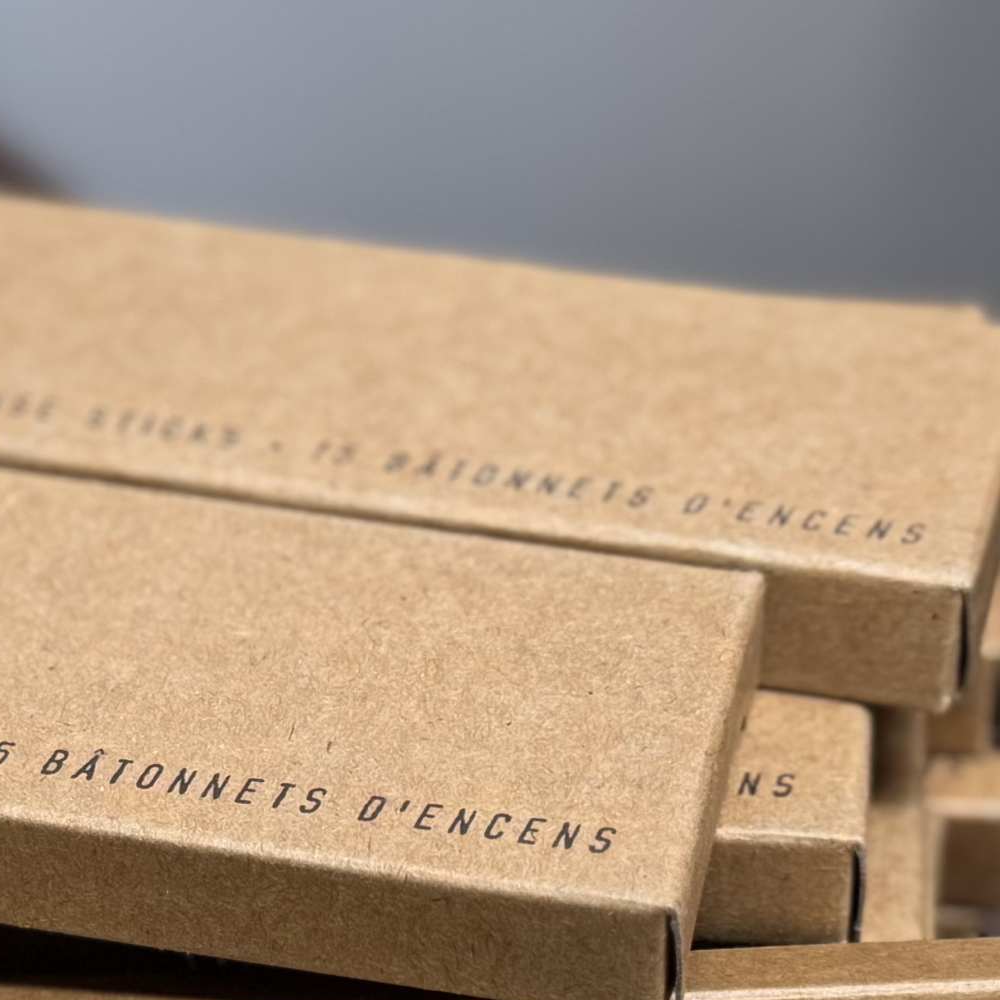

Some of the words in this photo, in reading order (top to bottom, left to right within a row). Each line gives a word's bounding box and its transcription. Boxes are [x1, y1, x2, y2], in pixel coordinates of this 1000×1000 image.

[383, 449, 656, 509] BÂTONNETS
[682, 494, 927, 546] D'ENCENS
[41, 748, 328, 815] BÂTONNETS
[356, 794, 618, 855] D'ENCENS
